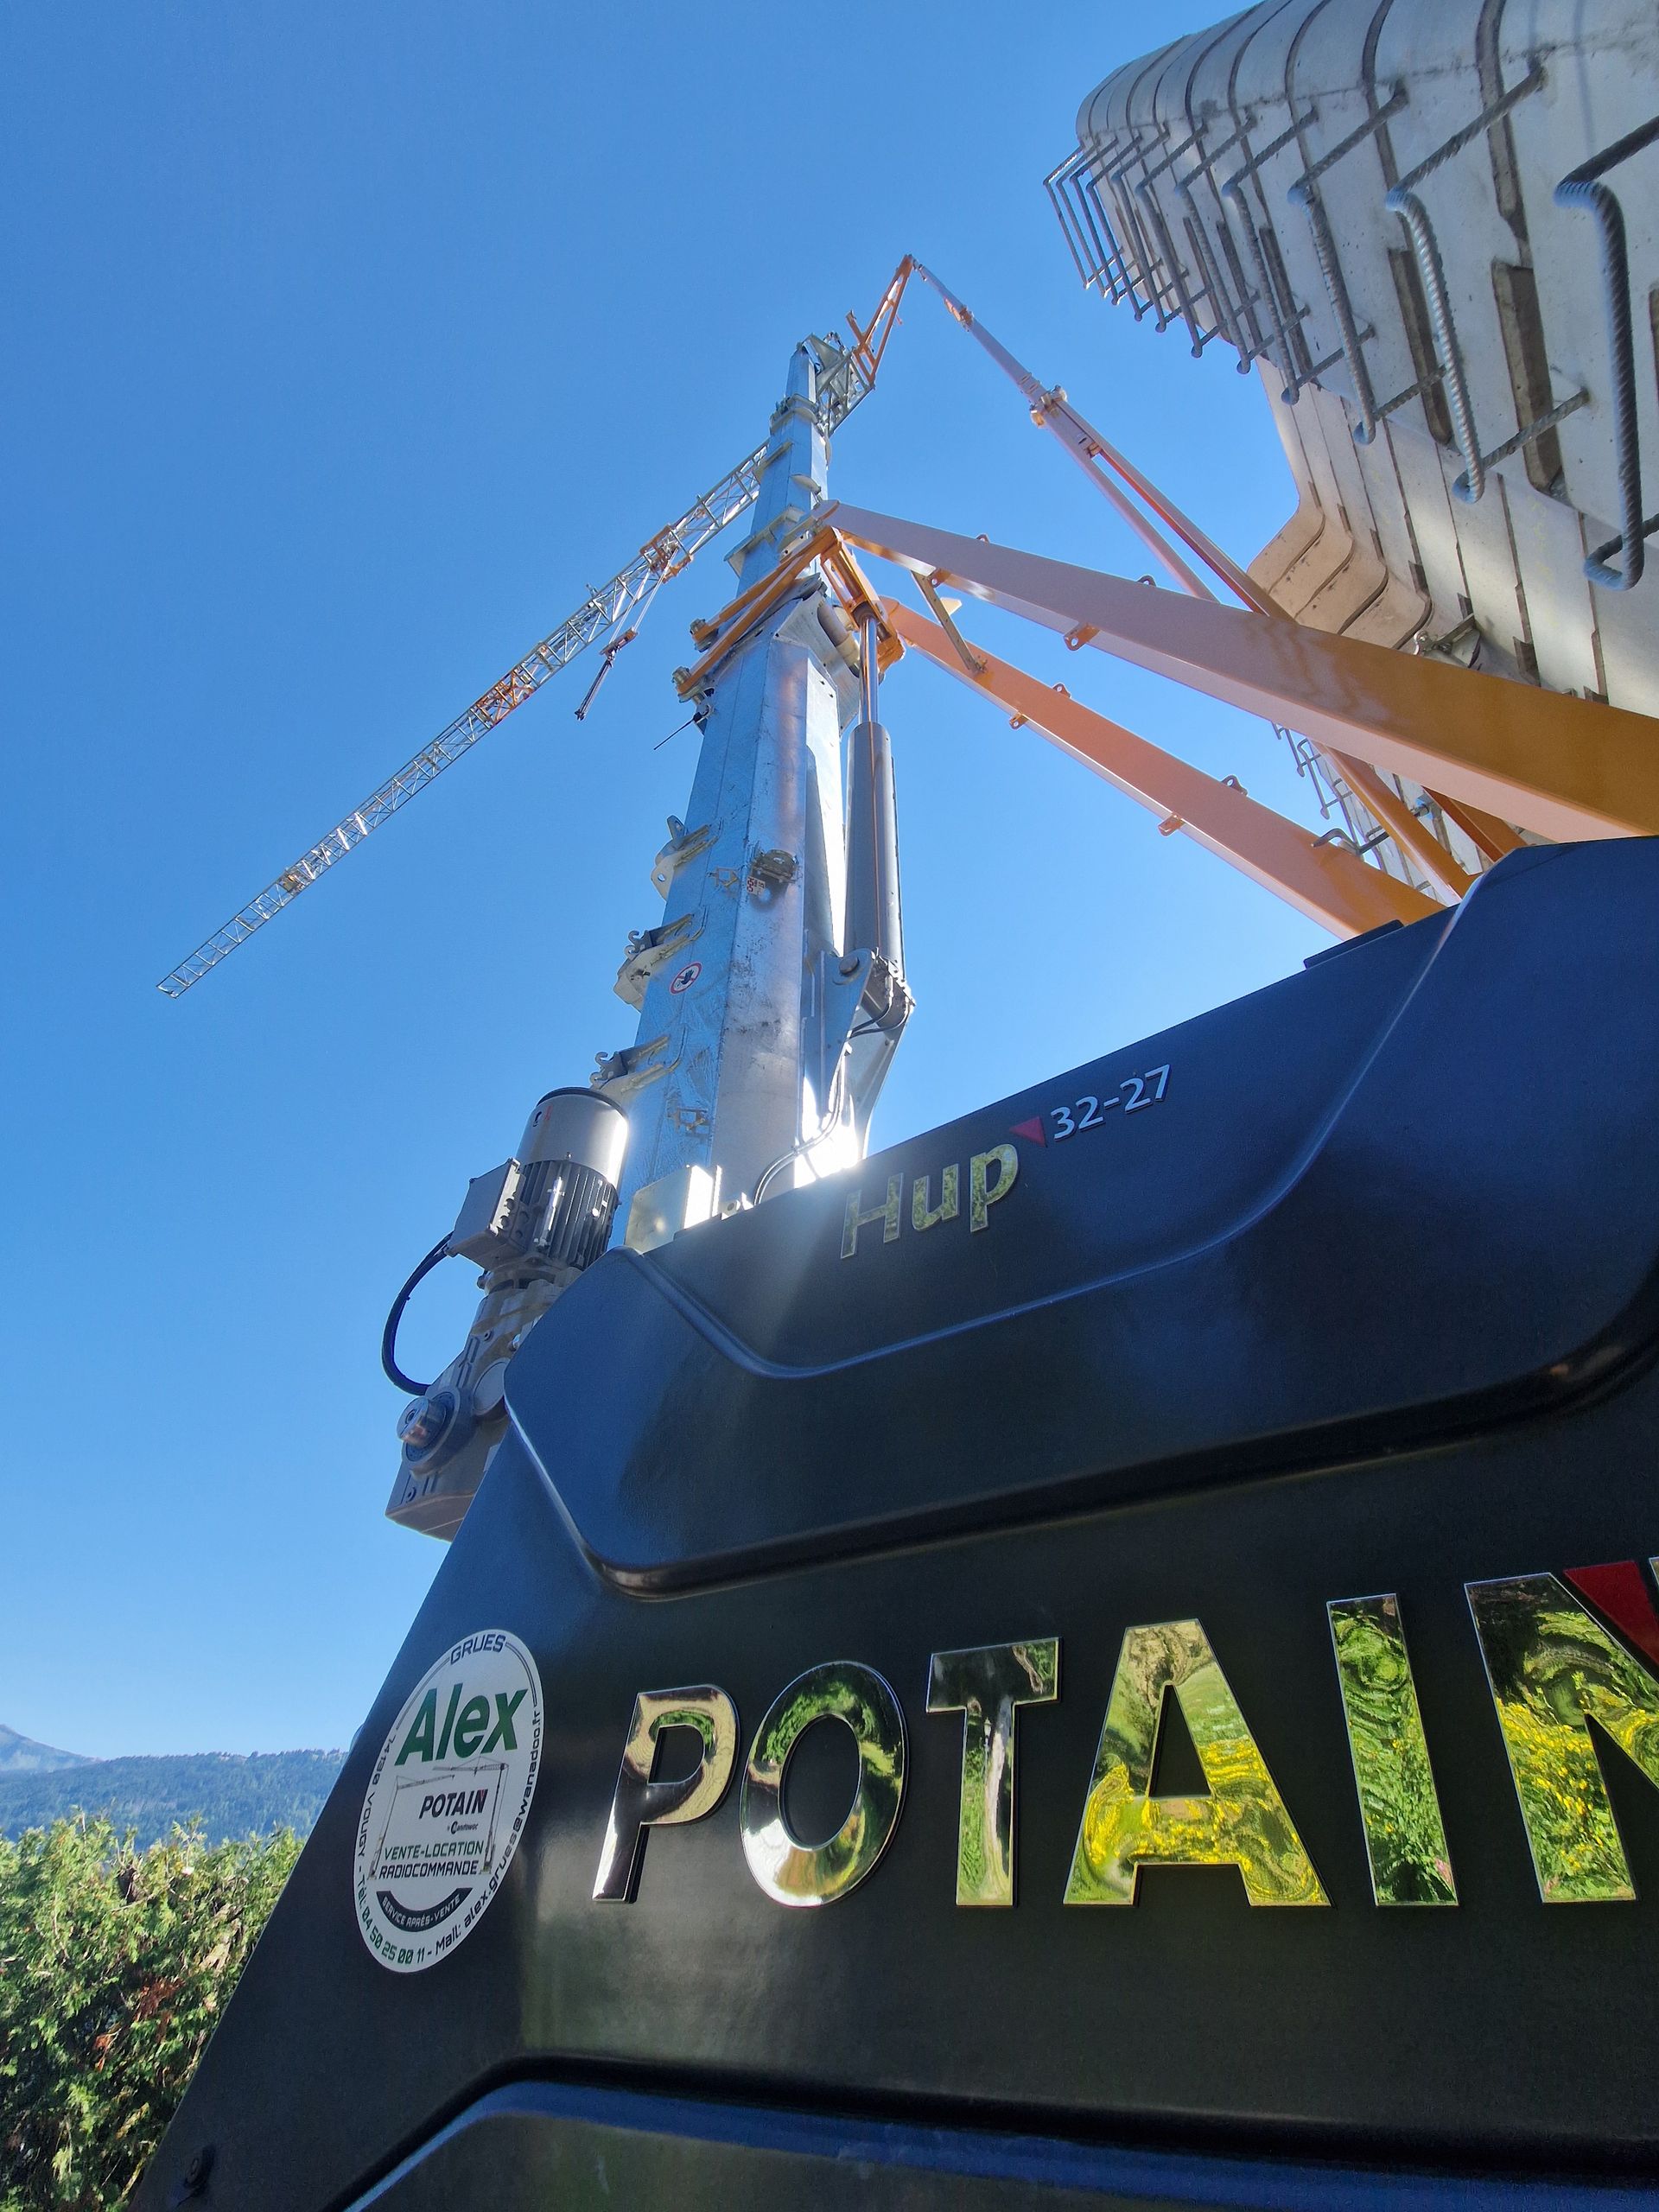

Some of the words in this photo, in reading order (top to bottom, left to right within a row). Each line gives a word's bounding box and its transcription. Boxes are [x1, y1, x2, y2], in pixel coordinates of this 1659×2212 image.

[840, 1142, 1020, 1259] Hup
[1050, 1064, 1172, 1141] 32-27
[450, 1633, 506, 1666] GRUES
[394, 1682, 529, 1766] Alex
[418, 1788, 489, 1820] POTAIN
[369, 1925, 383, 1949] 50
[381, 1942, 397, 1961] 25
[397, 1948, 414, 1964] 00
[464, 1710, 541, 1929] alex.grues@wanadoo.fr
[385, 1840, 484, 1861] VENTE-LOCATION
[378, 1859, 480, 1879] RADIOCOMMANDE
